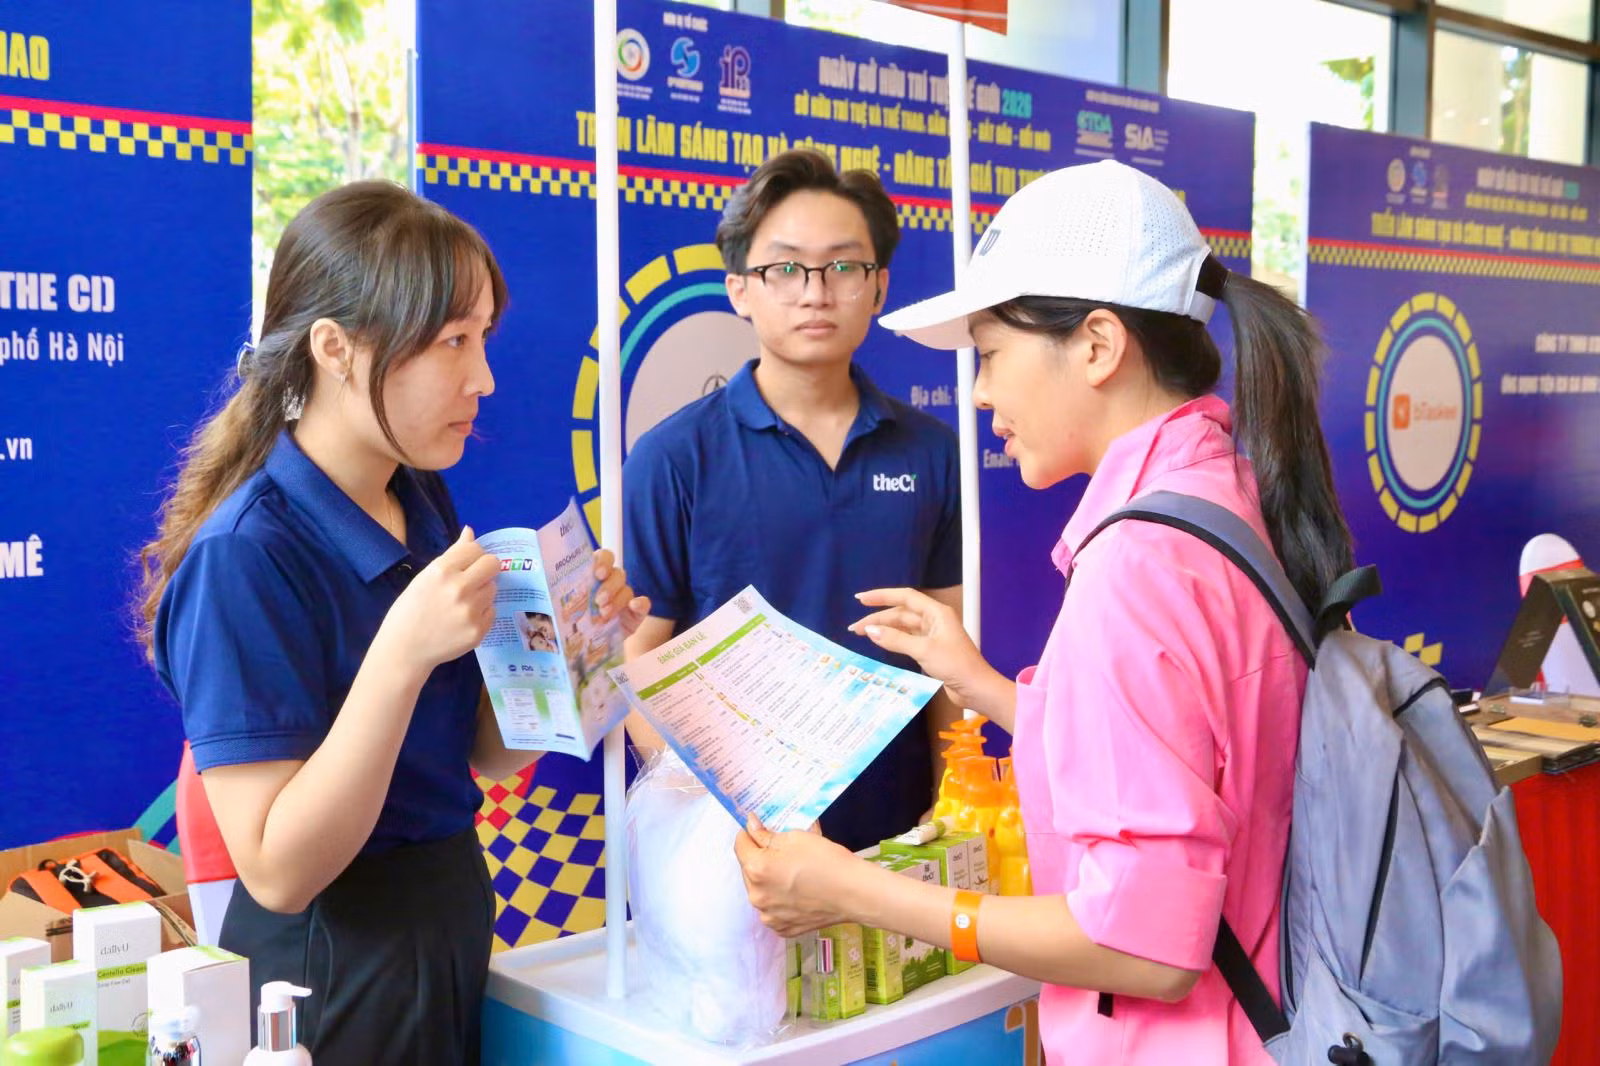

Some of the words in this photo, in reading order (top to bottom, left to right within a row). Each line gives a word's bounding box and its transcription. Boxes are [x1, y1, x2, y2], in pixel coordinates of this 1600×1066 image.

[636, 114, 676, 157] LÃM
[679, 121, 729, 164] SÁNG
[732, 131, 764, 174] TẠO
[894, 149, 935, 188] NÂNG
[48, 331, 79, 361] Hà
[87, 331, 124, 367] Nội
[872, 472, 917, 493] theCi
[500, 558, 533, 571] HTV
